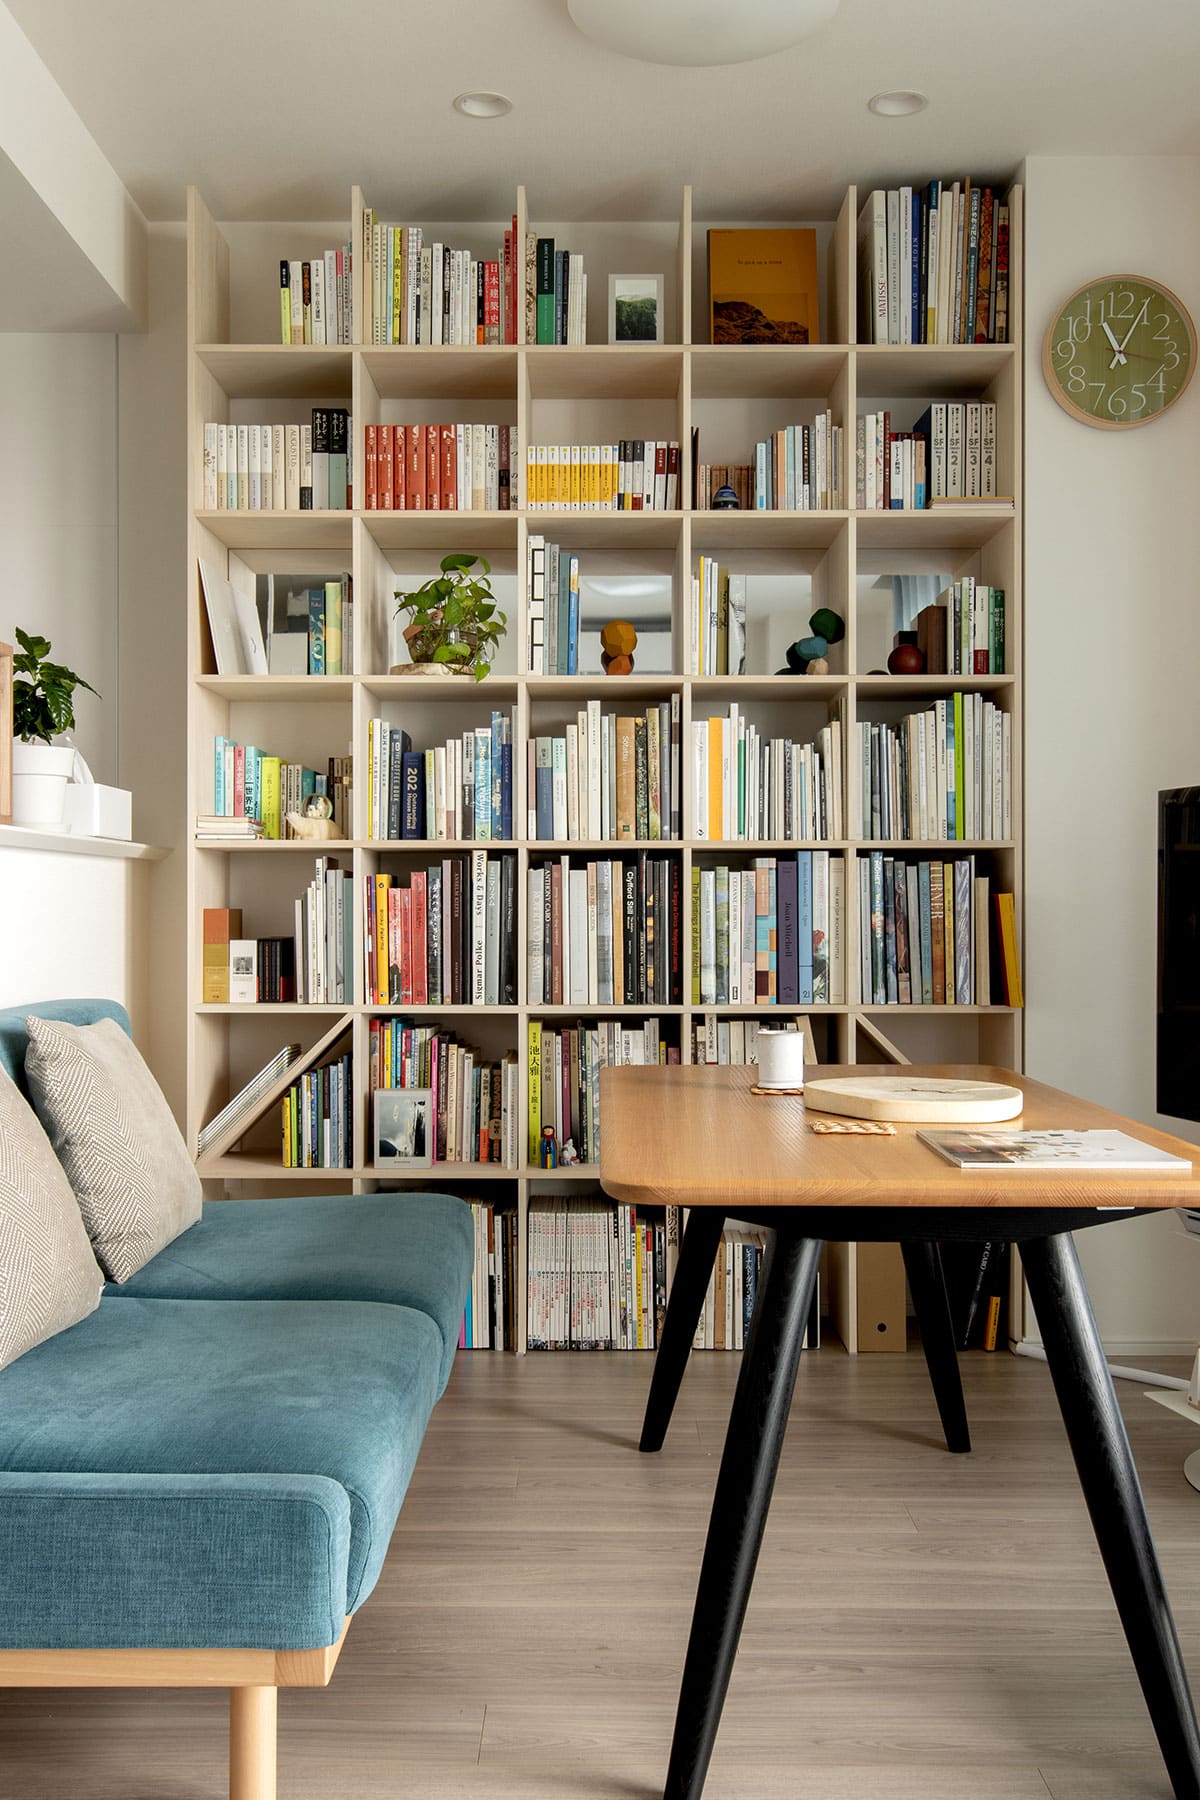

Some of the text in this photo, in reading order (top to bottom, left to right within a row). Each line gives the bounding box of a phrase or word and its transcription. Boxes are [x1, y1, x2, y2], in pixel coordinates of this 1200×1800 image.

[878, 279, 887, 318] MATISSE
[1107, 291, 1134, 318] 12
[1084, 299, 1105, 326] 11
[1066, 316, 1092, 343] 10
[1152, 313, 1170, 340] 2
[1057, 339, 1076, 370] 9
[1164, 341, 1180, 371] 3
[1068, 365, 1086, 392] 8
[1146, 364, 1167, 393] 4
[1088, 382, 1106, 411] 7
[1107, 385, 1127, 416] 6
[1131, 384, 1147, 413] 5
[934, 438, 944, 446] SF
[950, 438, 960, 446] SF
[968, 438, 979, 446] SF
[983, 438, 994, 446] SF
[936, 455, 941, 466] 1
[951, 455, 958, 466] 2
[970, 455, 977, 466] 3
[984, 455, 993, 466] 4
[407, 767, 418, 791] 202
[475, 853, 484, 882] Works
[626, 871, 634, 915] Clyfford Still
[691, 883, 699, 895] The
[931, 864, 943, 919] TURNER
[475, 894, 484, 916] Days
[691, 896, 699, 926] Paintings
[475, 940, 483, 1000] Sigmar Polke
[530, 1045, 540, 1076] 池大雅
